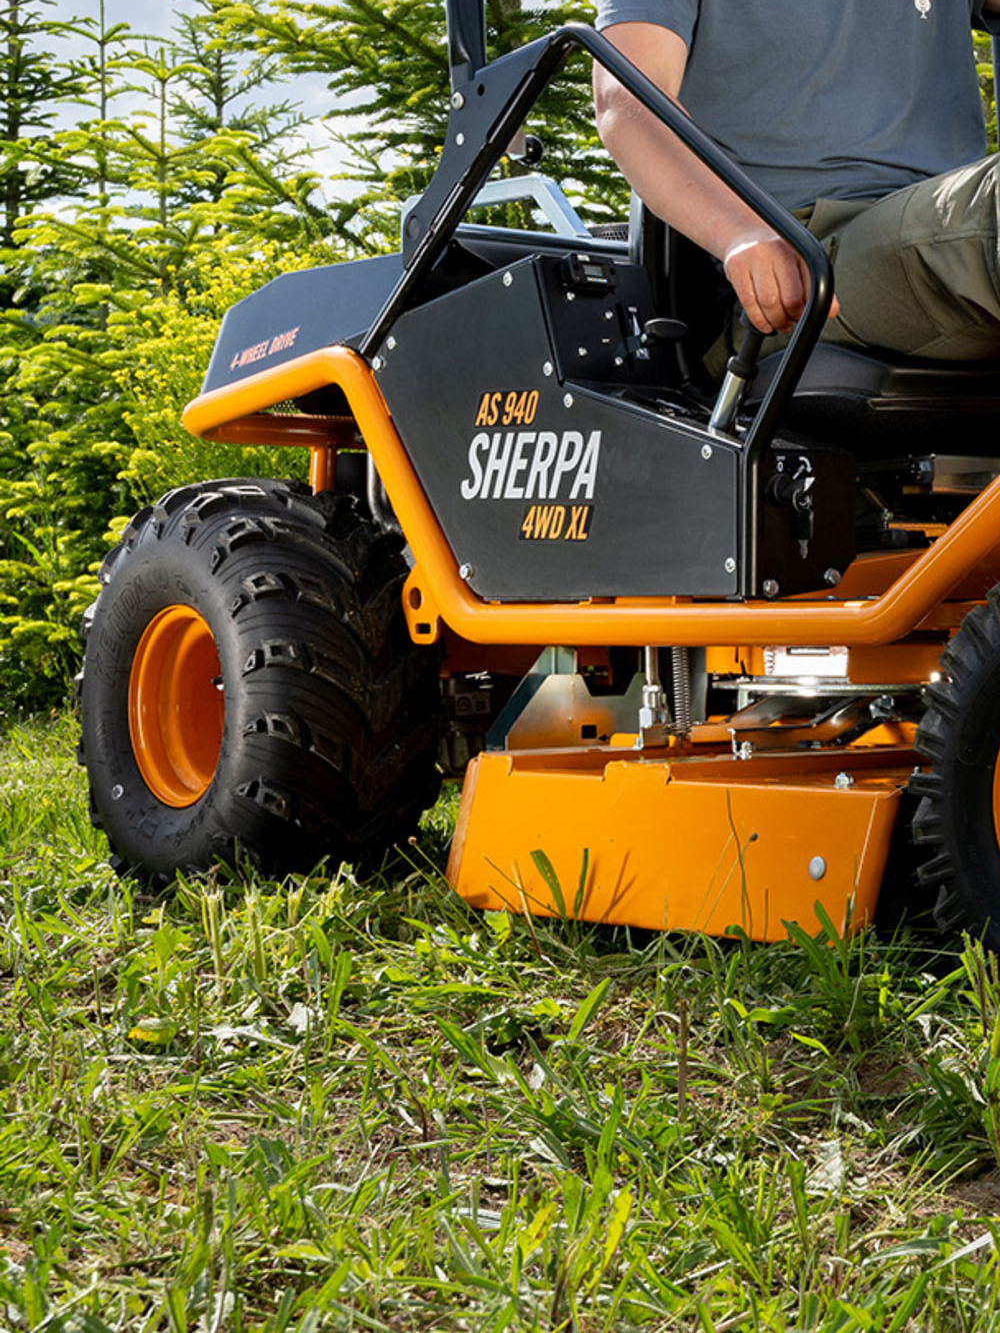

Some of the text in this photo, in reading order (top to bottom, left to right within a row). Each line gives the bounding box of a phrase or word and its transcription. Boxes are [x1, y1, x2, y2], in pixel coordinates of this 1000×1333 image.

[475, 390, 539, 426] AS 940
[461, 431, 601, 500] SHERPA
[521, 505, 588, 540] 4WD XL
